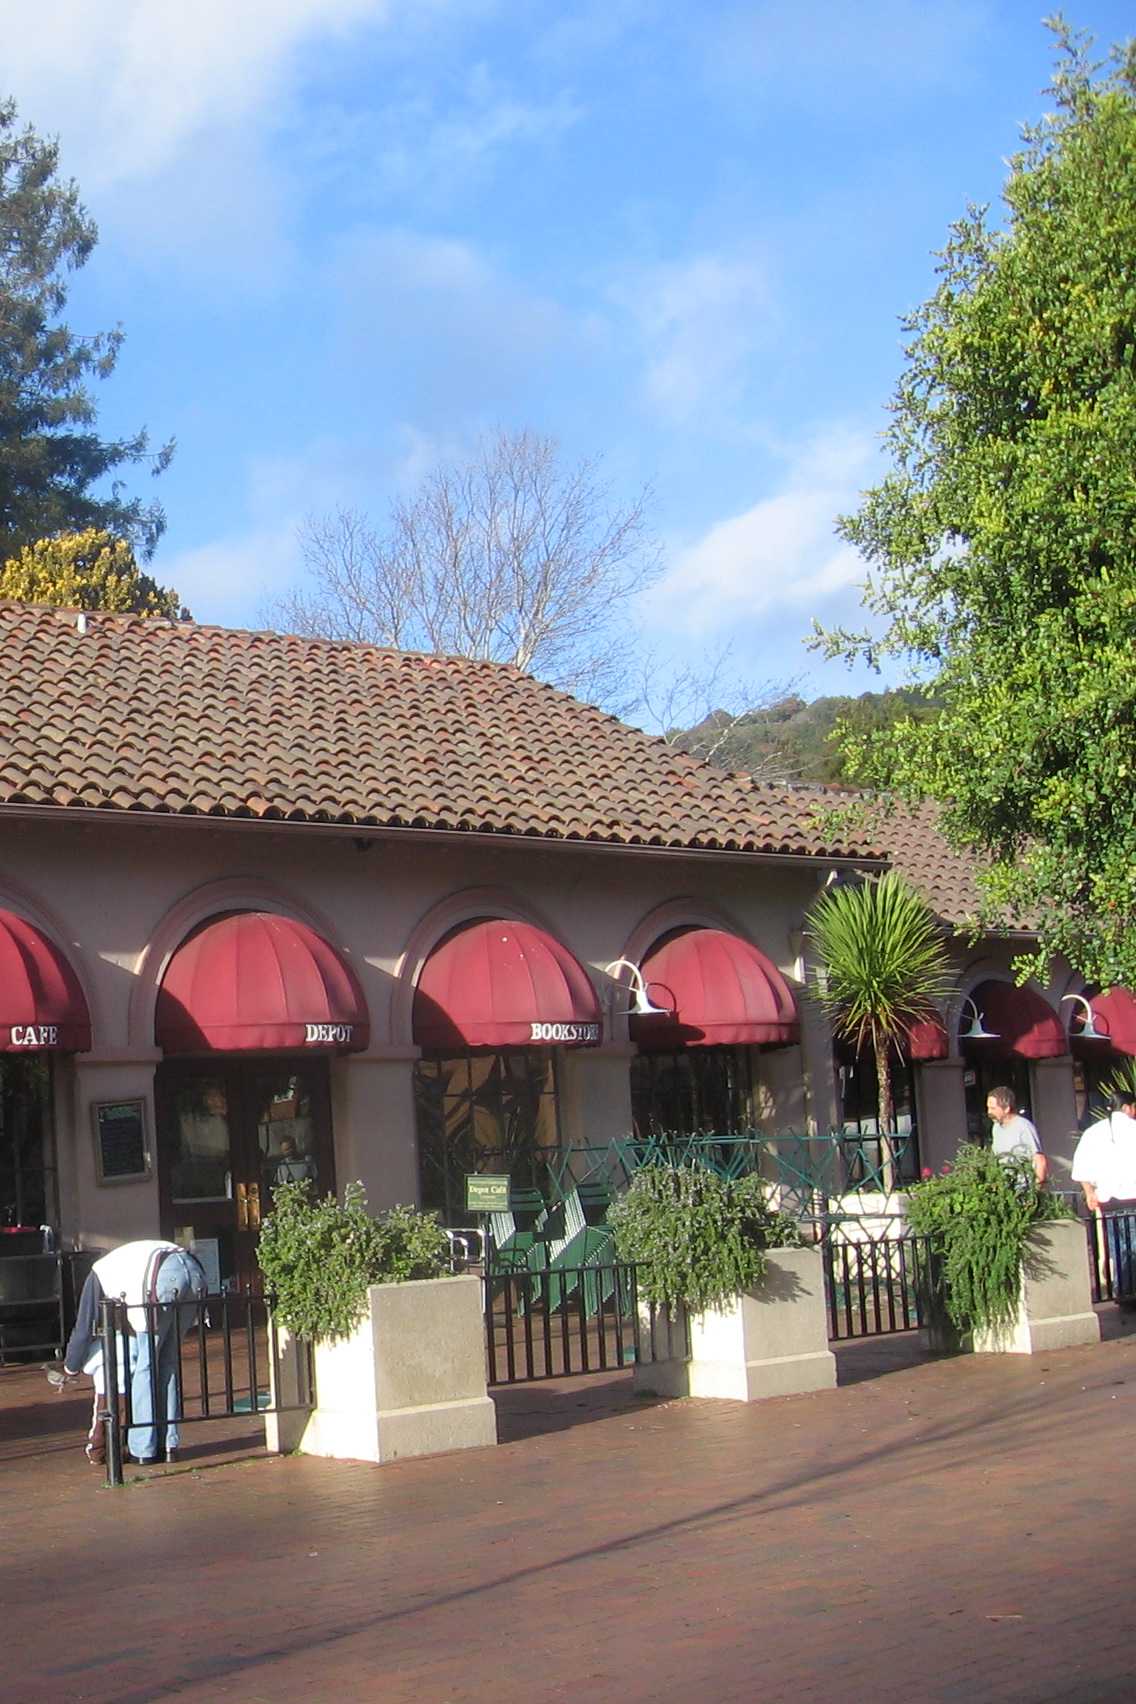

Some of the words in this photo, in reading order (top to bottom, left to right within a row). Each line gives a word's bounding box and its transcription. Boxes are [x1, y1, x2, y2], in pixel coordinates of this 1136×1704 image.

[11, 1025, 58, 1045] CAFE
[305, 1024, 353, 1042] DEPOT
[469, 1185, 489, 1195] Depot
